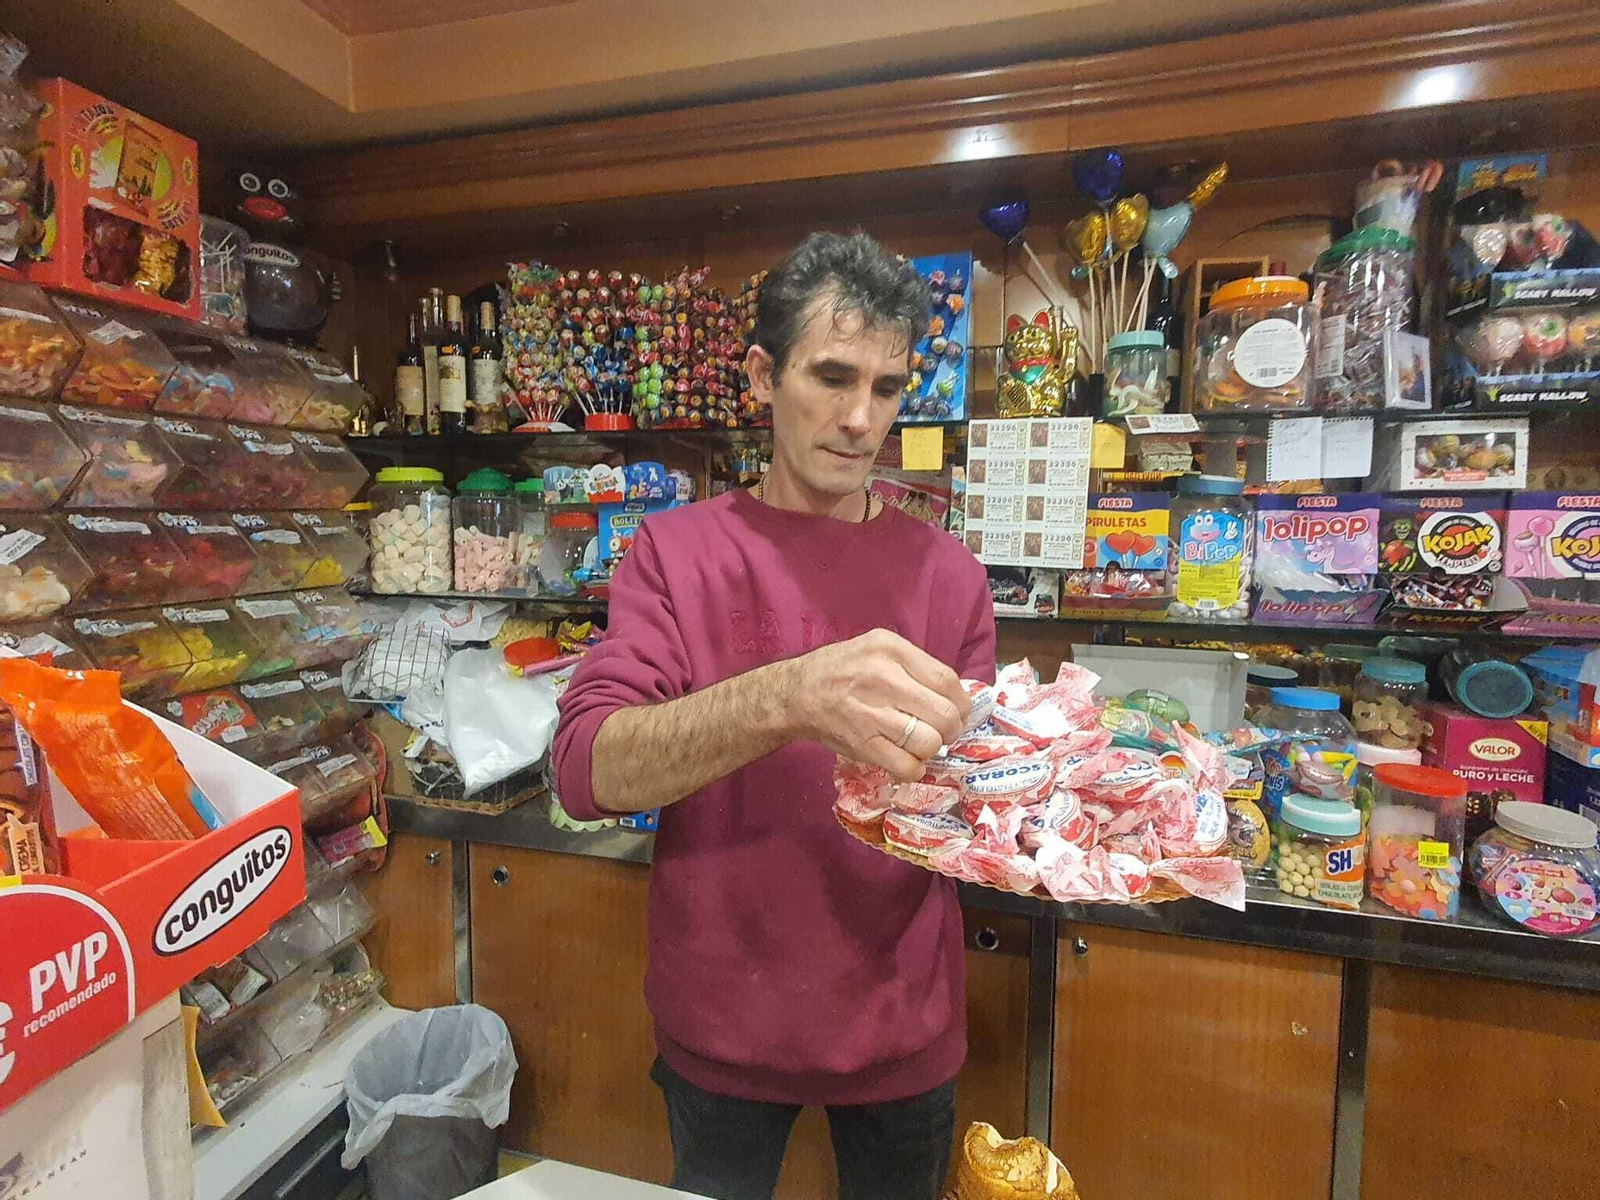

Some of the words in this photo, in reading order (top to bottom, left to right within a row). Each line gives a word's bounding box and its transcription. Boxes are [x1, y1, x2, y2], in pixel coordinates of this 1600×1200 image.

[1098, 497, 1133, 509] FIESTA
[1297, 496, 1338, 508] FIESTA
[612, 514, 642, 527] BOLIT
[1264, 513, 1369, 544] lolipop
[1421, 522, 1495, 555] KOJAK
[1550, 534, 1600, 559] KOJ
[1474, 743, 1516, 756] VALOR
[1495, 772, 1535, 784] LECHE
[164, 834, 288, 946] conguitos
[29, 930, 109, 1014] PVP
[23, 971, 117, 1038] recomendado
